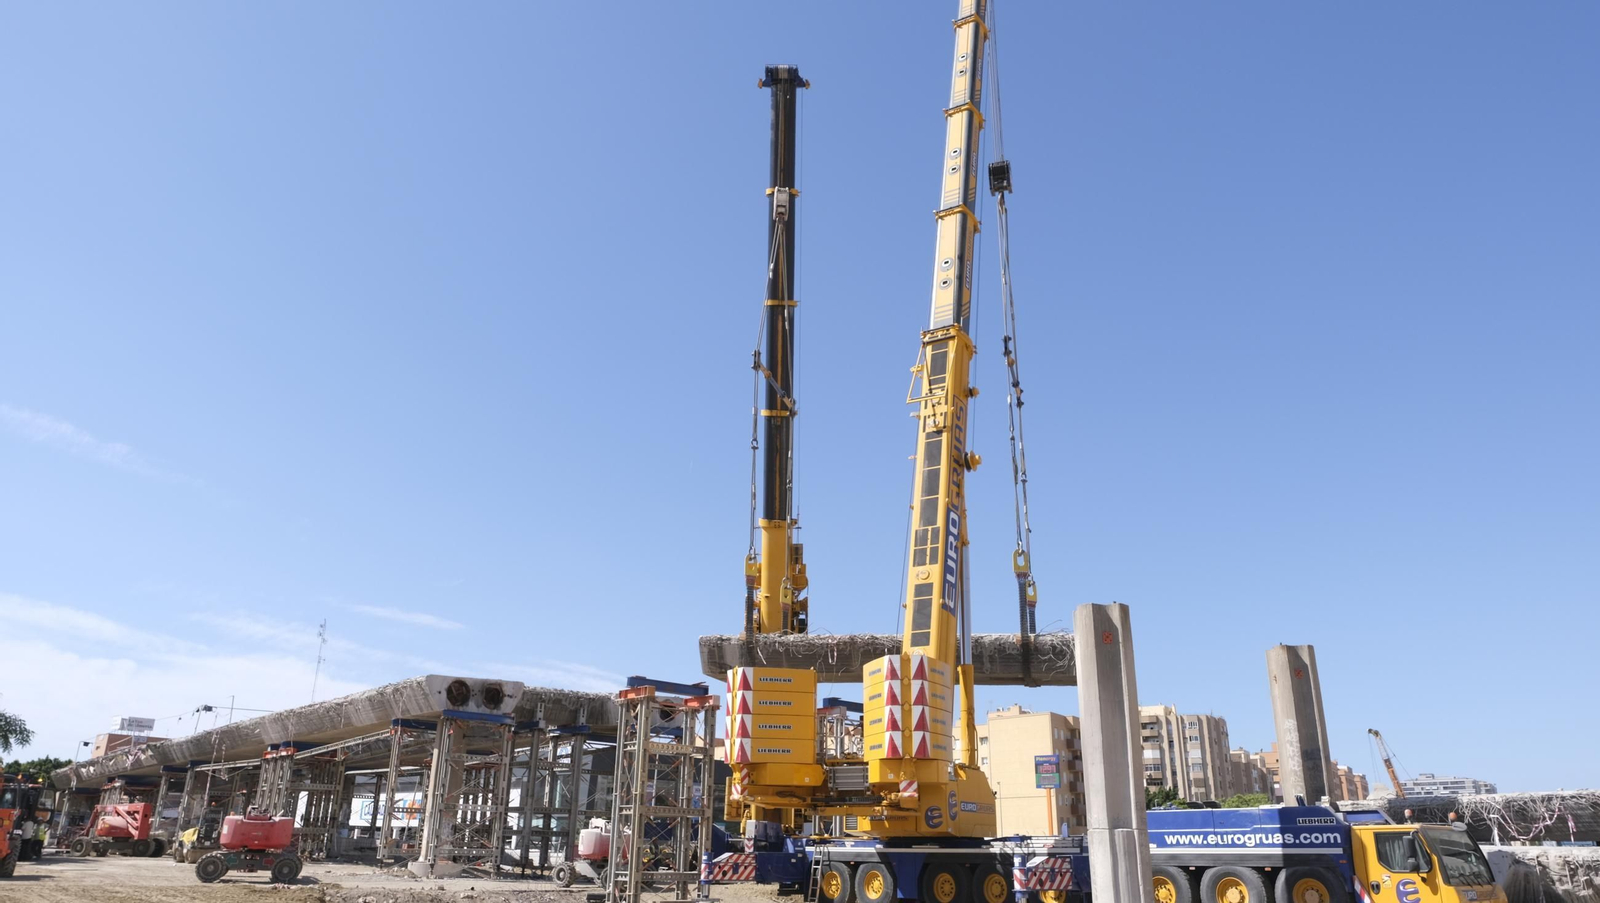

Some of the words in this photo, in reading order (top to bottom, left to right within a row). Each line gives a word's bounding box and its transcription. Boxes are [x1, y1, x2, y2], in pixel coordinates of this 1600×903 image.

[758, 676, 793, 684] LIEBHERR
[1296, 817, 1337, 825] LIEBHERR
[1164, 832, 1342, 848] www.eurogruas.com
